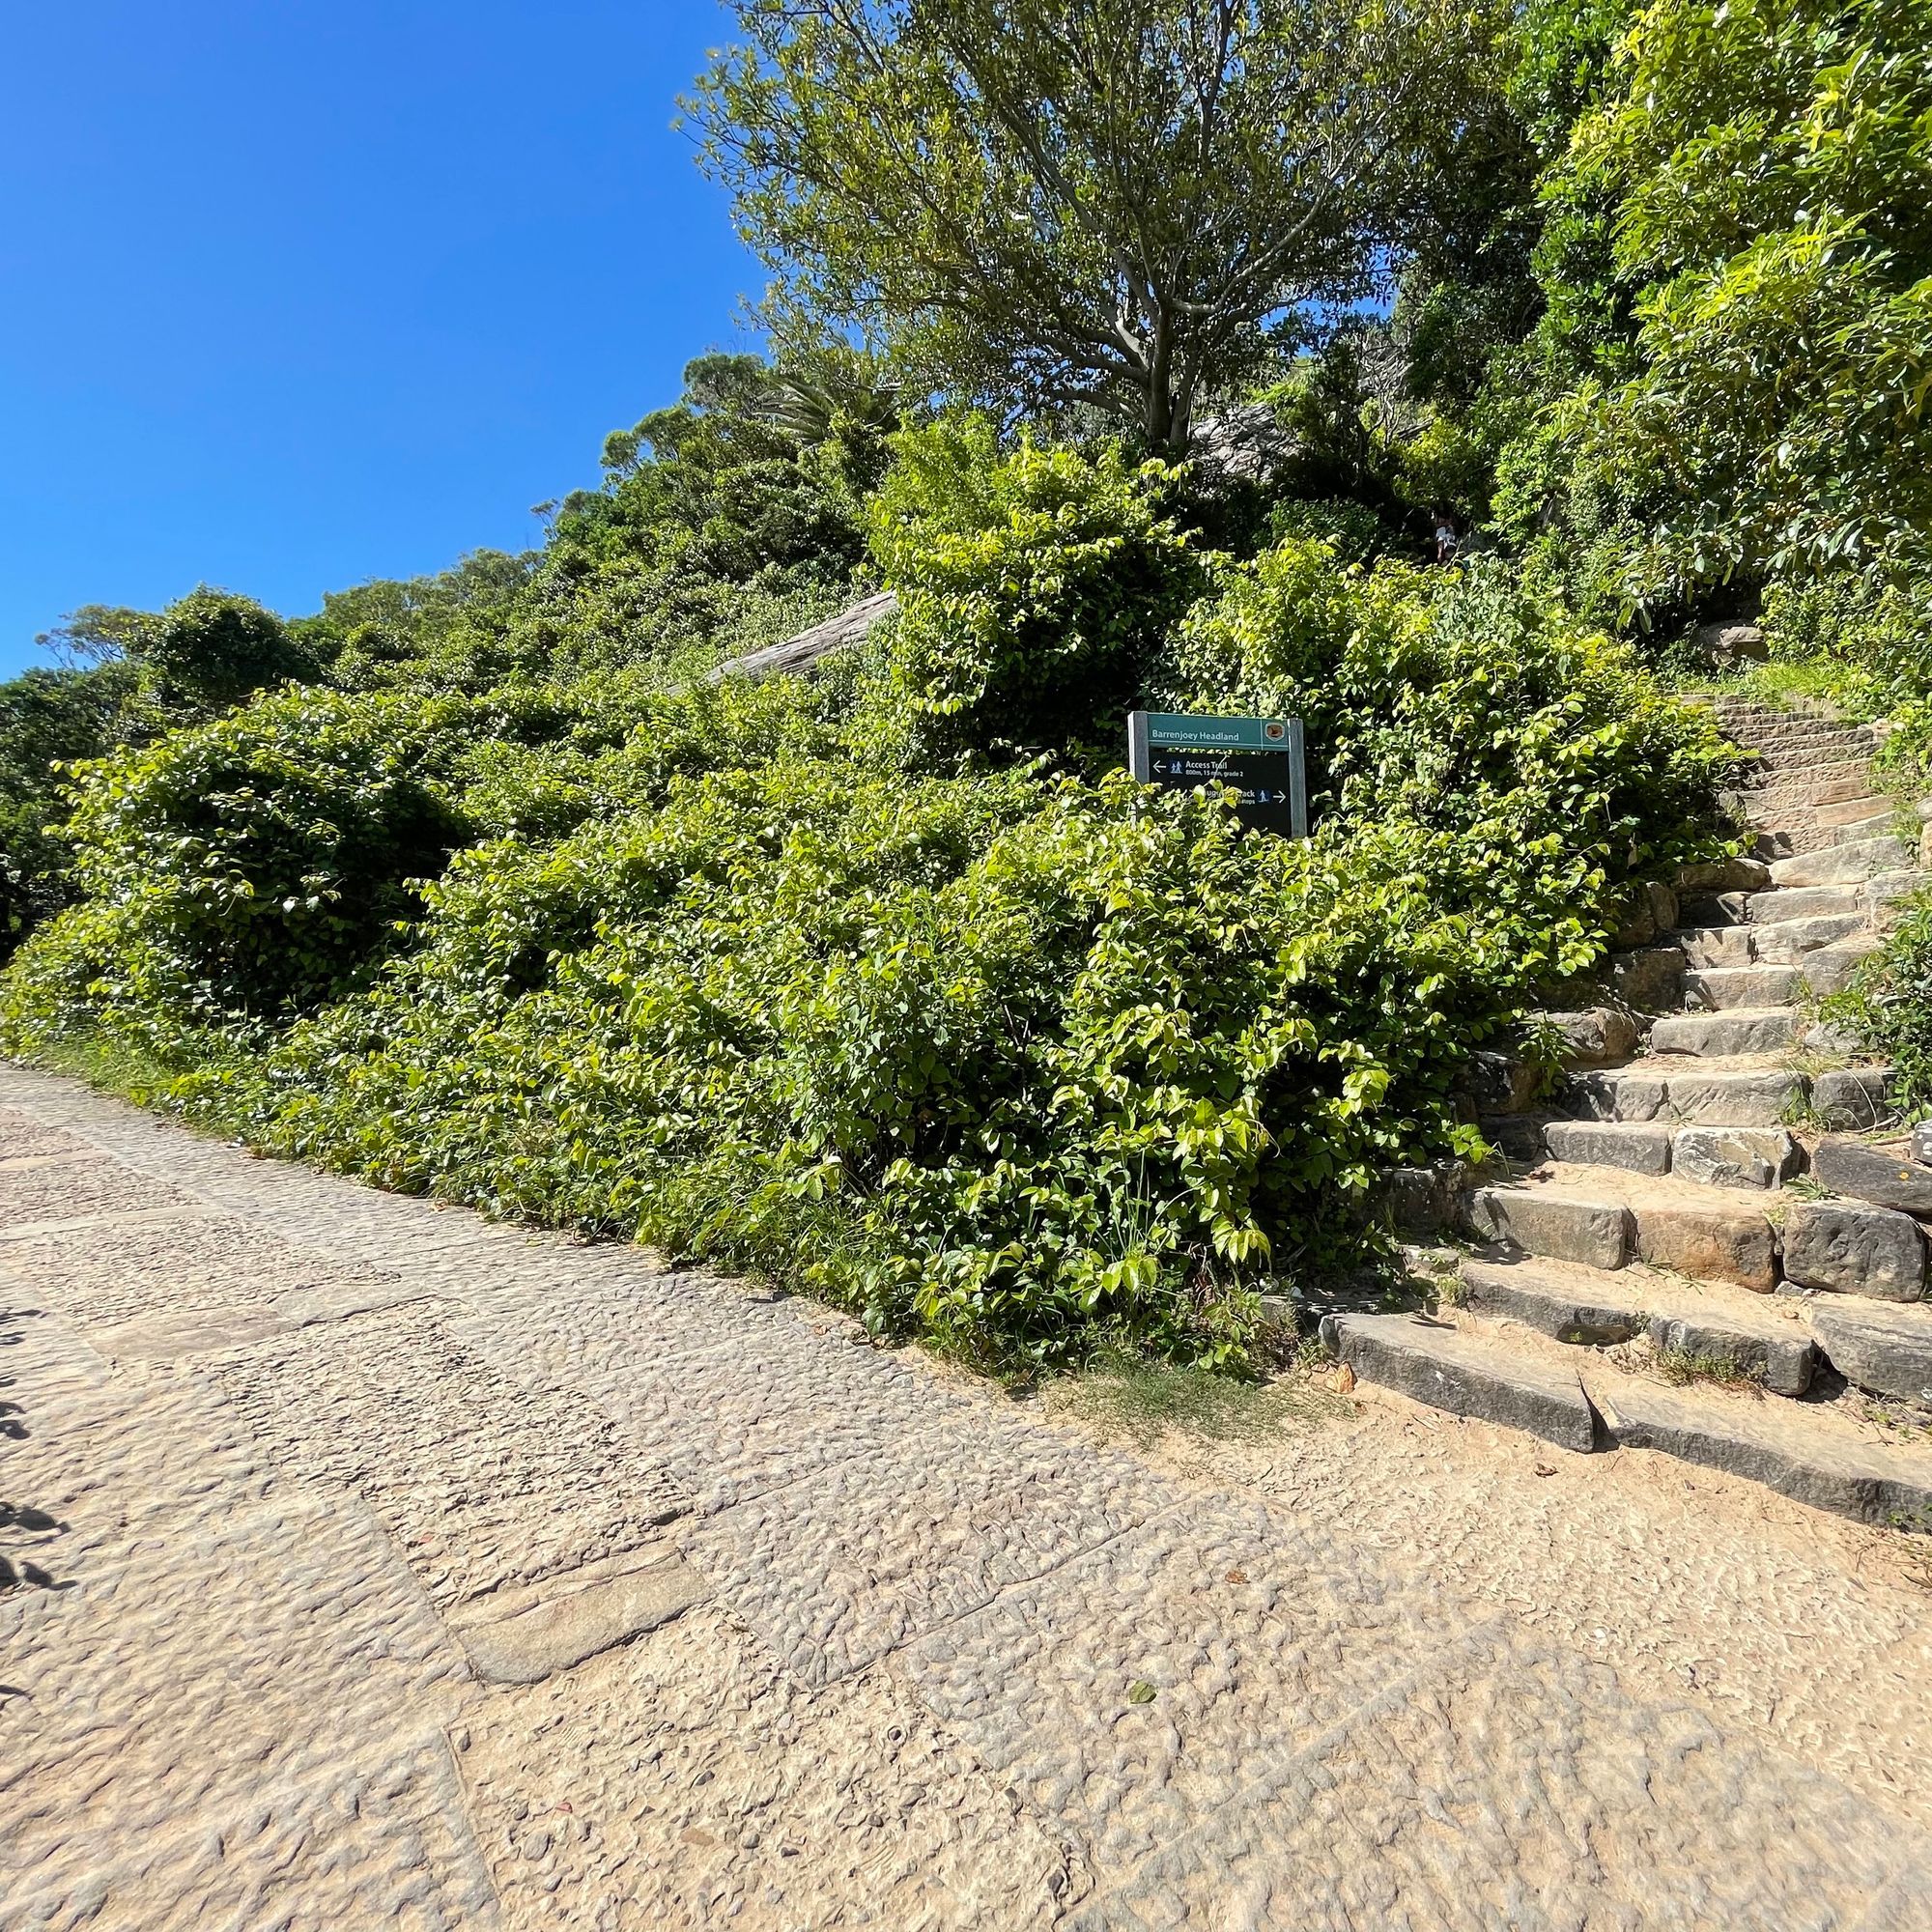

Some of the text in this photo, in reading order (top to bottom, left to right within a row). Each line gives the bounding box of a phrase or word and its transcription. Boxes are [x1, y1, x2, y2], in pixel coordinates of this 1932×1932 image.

[1151, 729, 1239, 742] Barrenjoey Headland
[1185, 760, 1210, 769] Access
